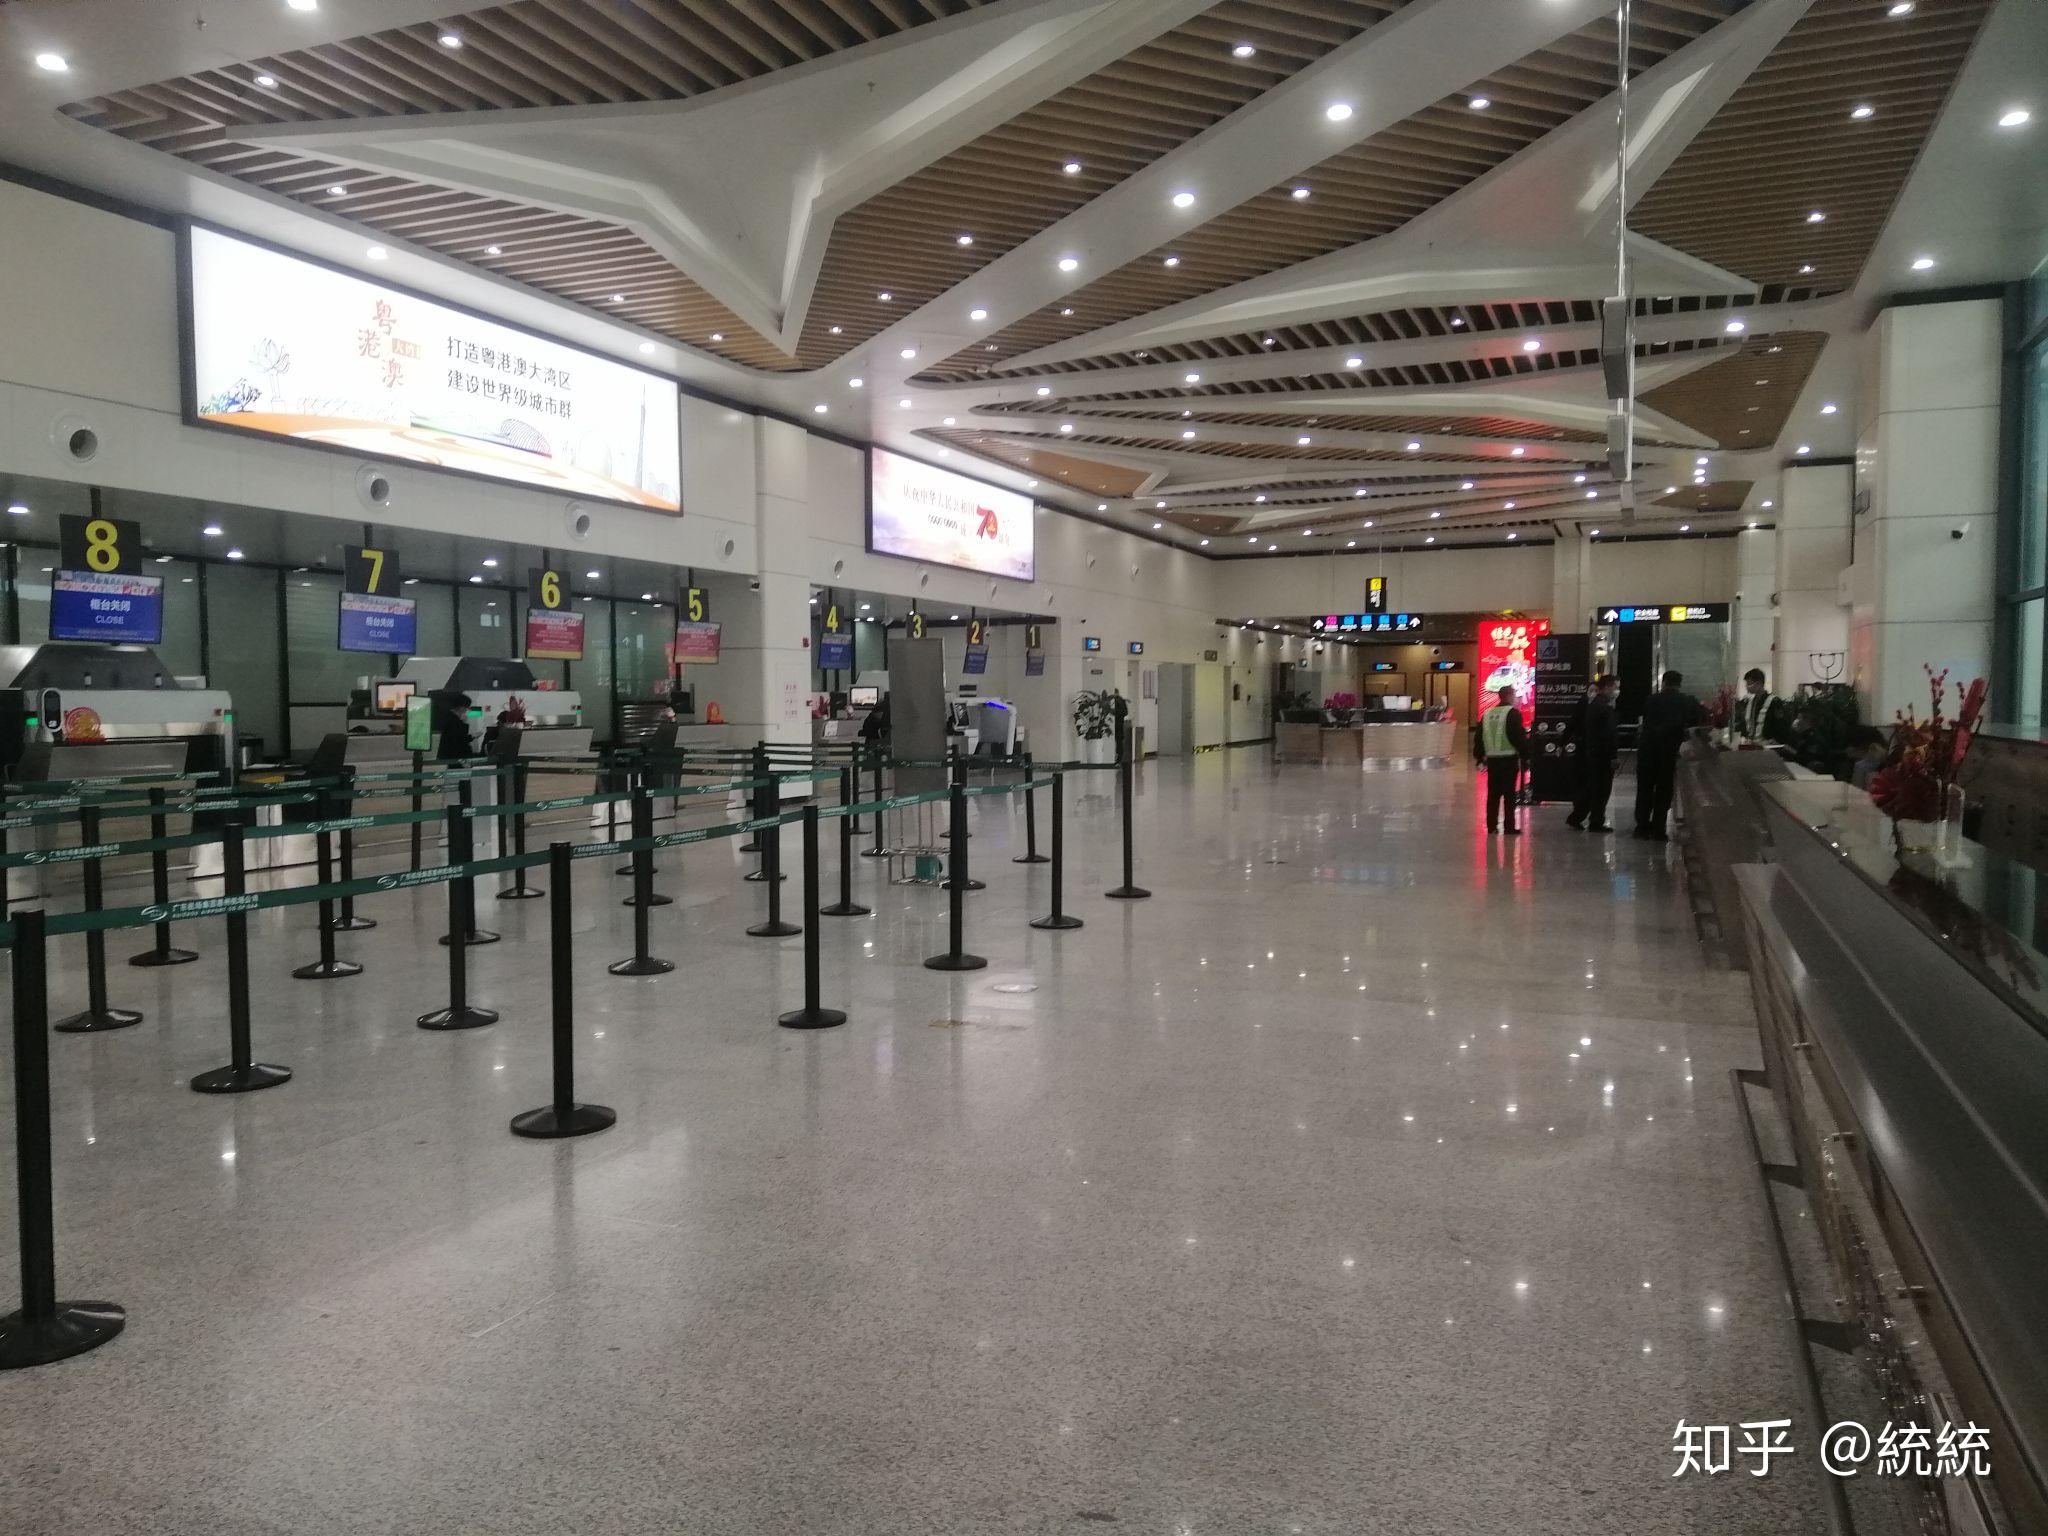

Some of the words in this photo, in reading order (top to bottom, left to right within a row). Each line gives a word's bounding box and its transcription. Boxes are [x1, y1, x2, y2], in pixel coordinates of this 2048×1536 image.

[447, 336, 572, 391] 打造粤港澳大湾区
[447, 369, 572, 419] 建设世界级城市群
[85, 519, 120, 572] 8
[361, 549, 384, 593] 7
[90, 598, 131, 612] 柜台关闭
[541, 571, 561, 609] 6
[688, 588, 703, 622] 5
[95, 615, 124, 625] CLOSE
[826, 605, 839, 633] 4
[912, 614, 922, 639] 3
[971, 621, 980, 645] 2
[1029, 626, 1036, 647] 1
